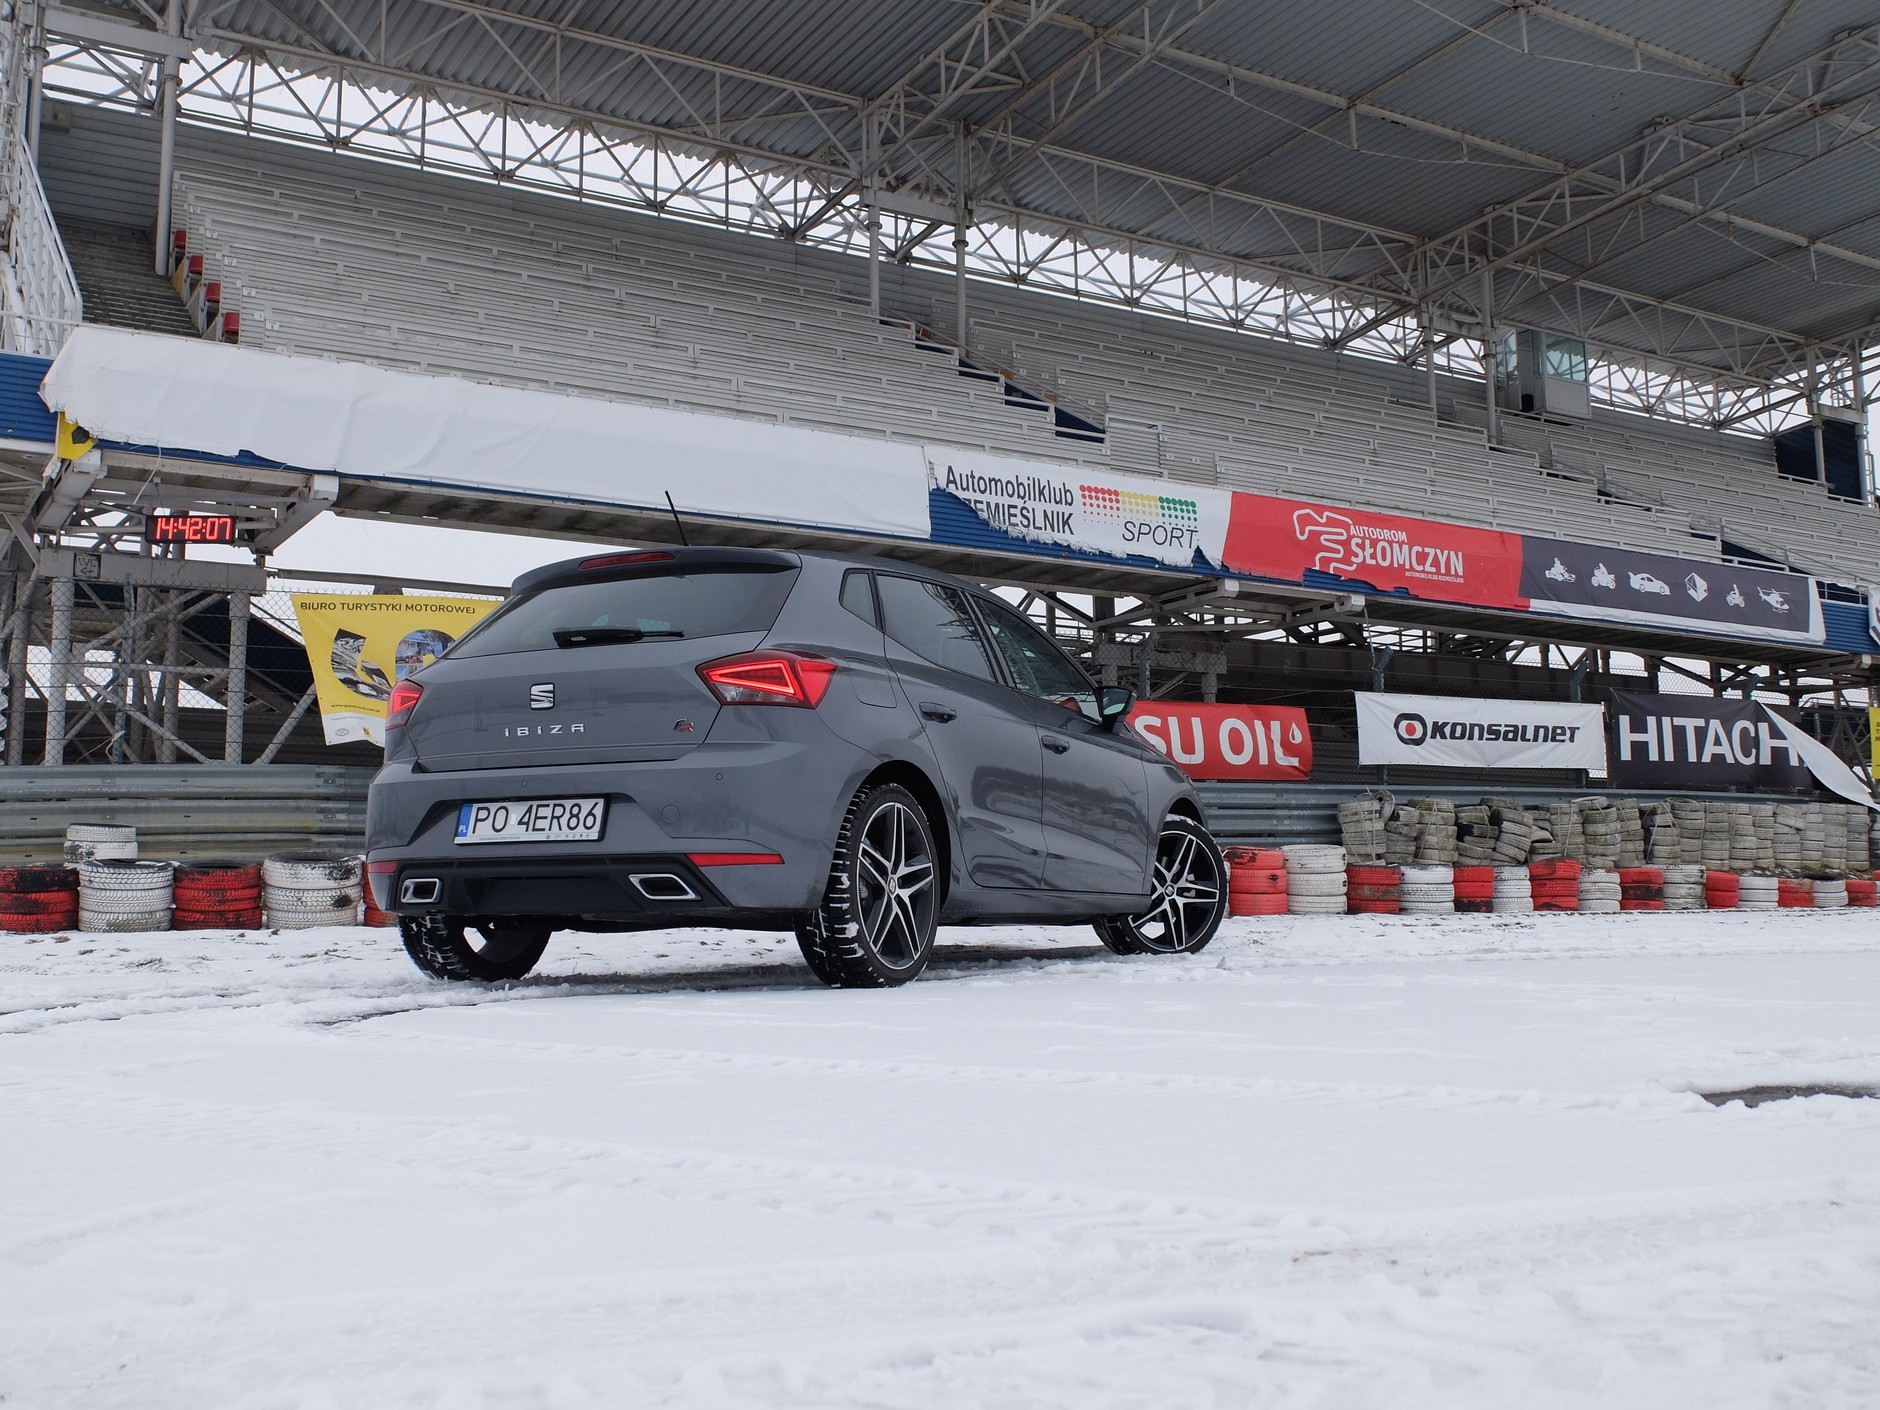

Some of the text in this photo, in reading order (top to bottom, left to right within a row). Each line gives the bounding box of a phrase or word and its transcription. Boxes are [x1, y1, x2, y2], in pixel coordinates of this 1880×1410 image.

[945, 465, 1074, 507] Automobilklub
[156, 517, 231, 540] 14:42:07
[1122, 520, 1199, 550] SPORT
[1350, 524, 1408, 543] AUTODROM
[78, 557, 97, 568] WC
[1350, 537, 1464, 576] SŁOMCZYN
[300, 602, 476, 615] BIURO TURYSTYKI MOTOROWEJ
[504, 723, 585, 737] IBIZA
[1134, 715, 1300, 767] SU OIL
[1618, 714, 1808, 768] HITACH
[458, 825, 467, 833] PL
[472, 802, 599, 834] PO 4ER86
